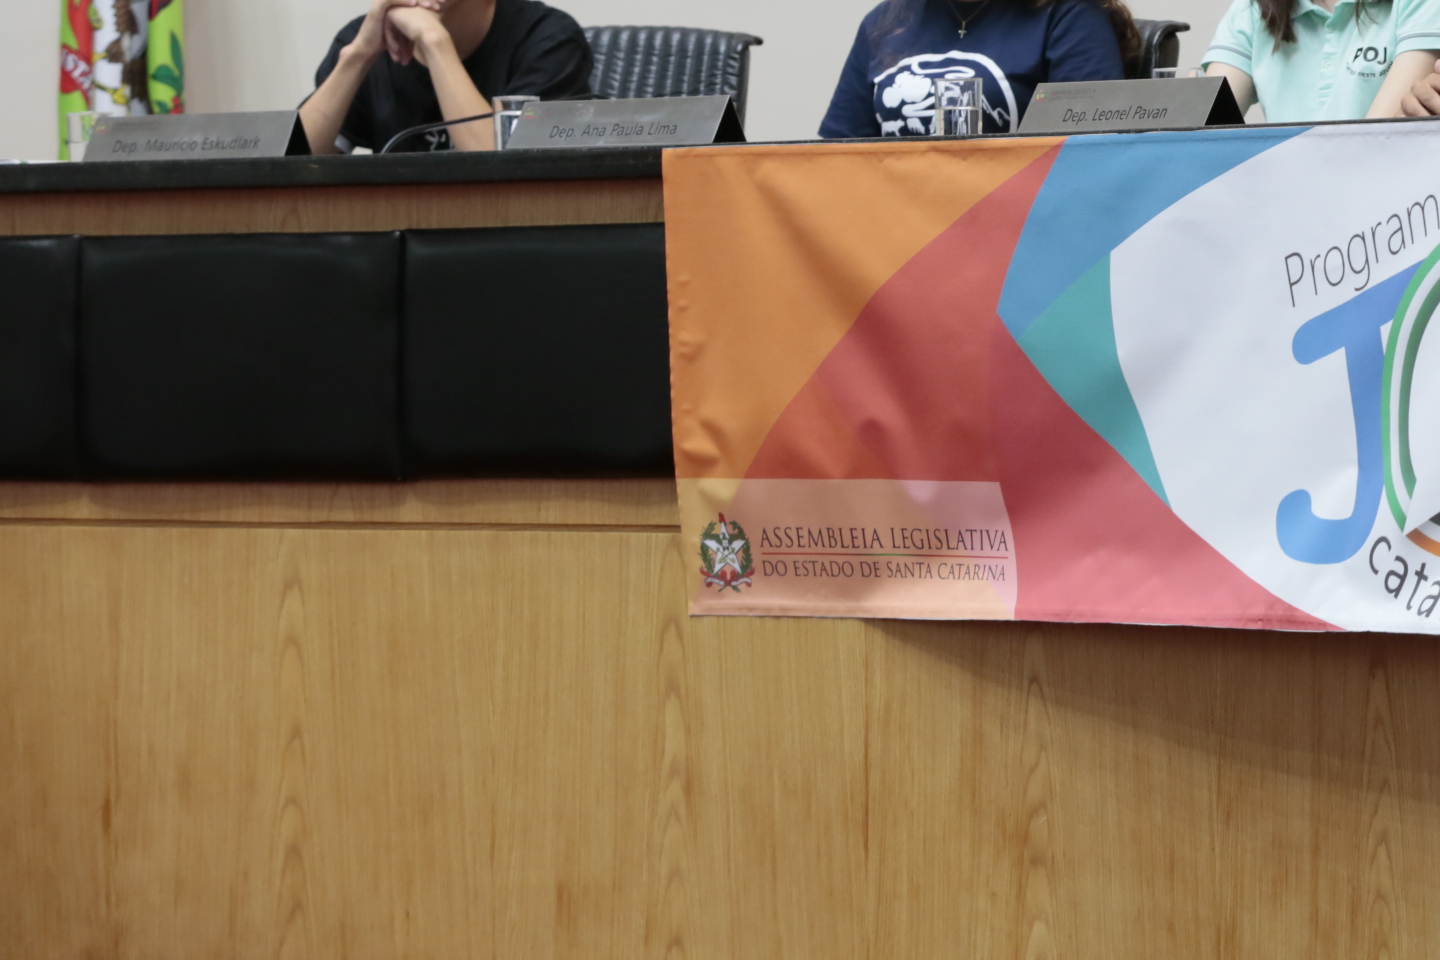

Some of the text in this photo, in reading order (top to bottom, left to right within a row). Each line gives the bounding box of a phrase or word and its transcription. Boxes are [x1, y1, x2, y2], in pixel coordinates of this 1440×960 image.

[1062, 105, 1168, 125] Dep. Leonel Pavan
[549, 121, 678, 141] Dep. Ana Paula Lima
[759, 526, 1009, 553] ASSEMBLEIA LEGISLATIVA
[762, 560, 1007, 583] DO ESTADO DE SANTA CATARINA
